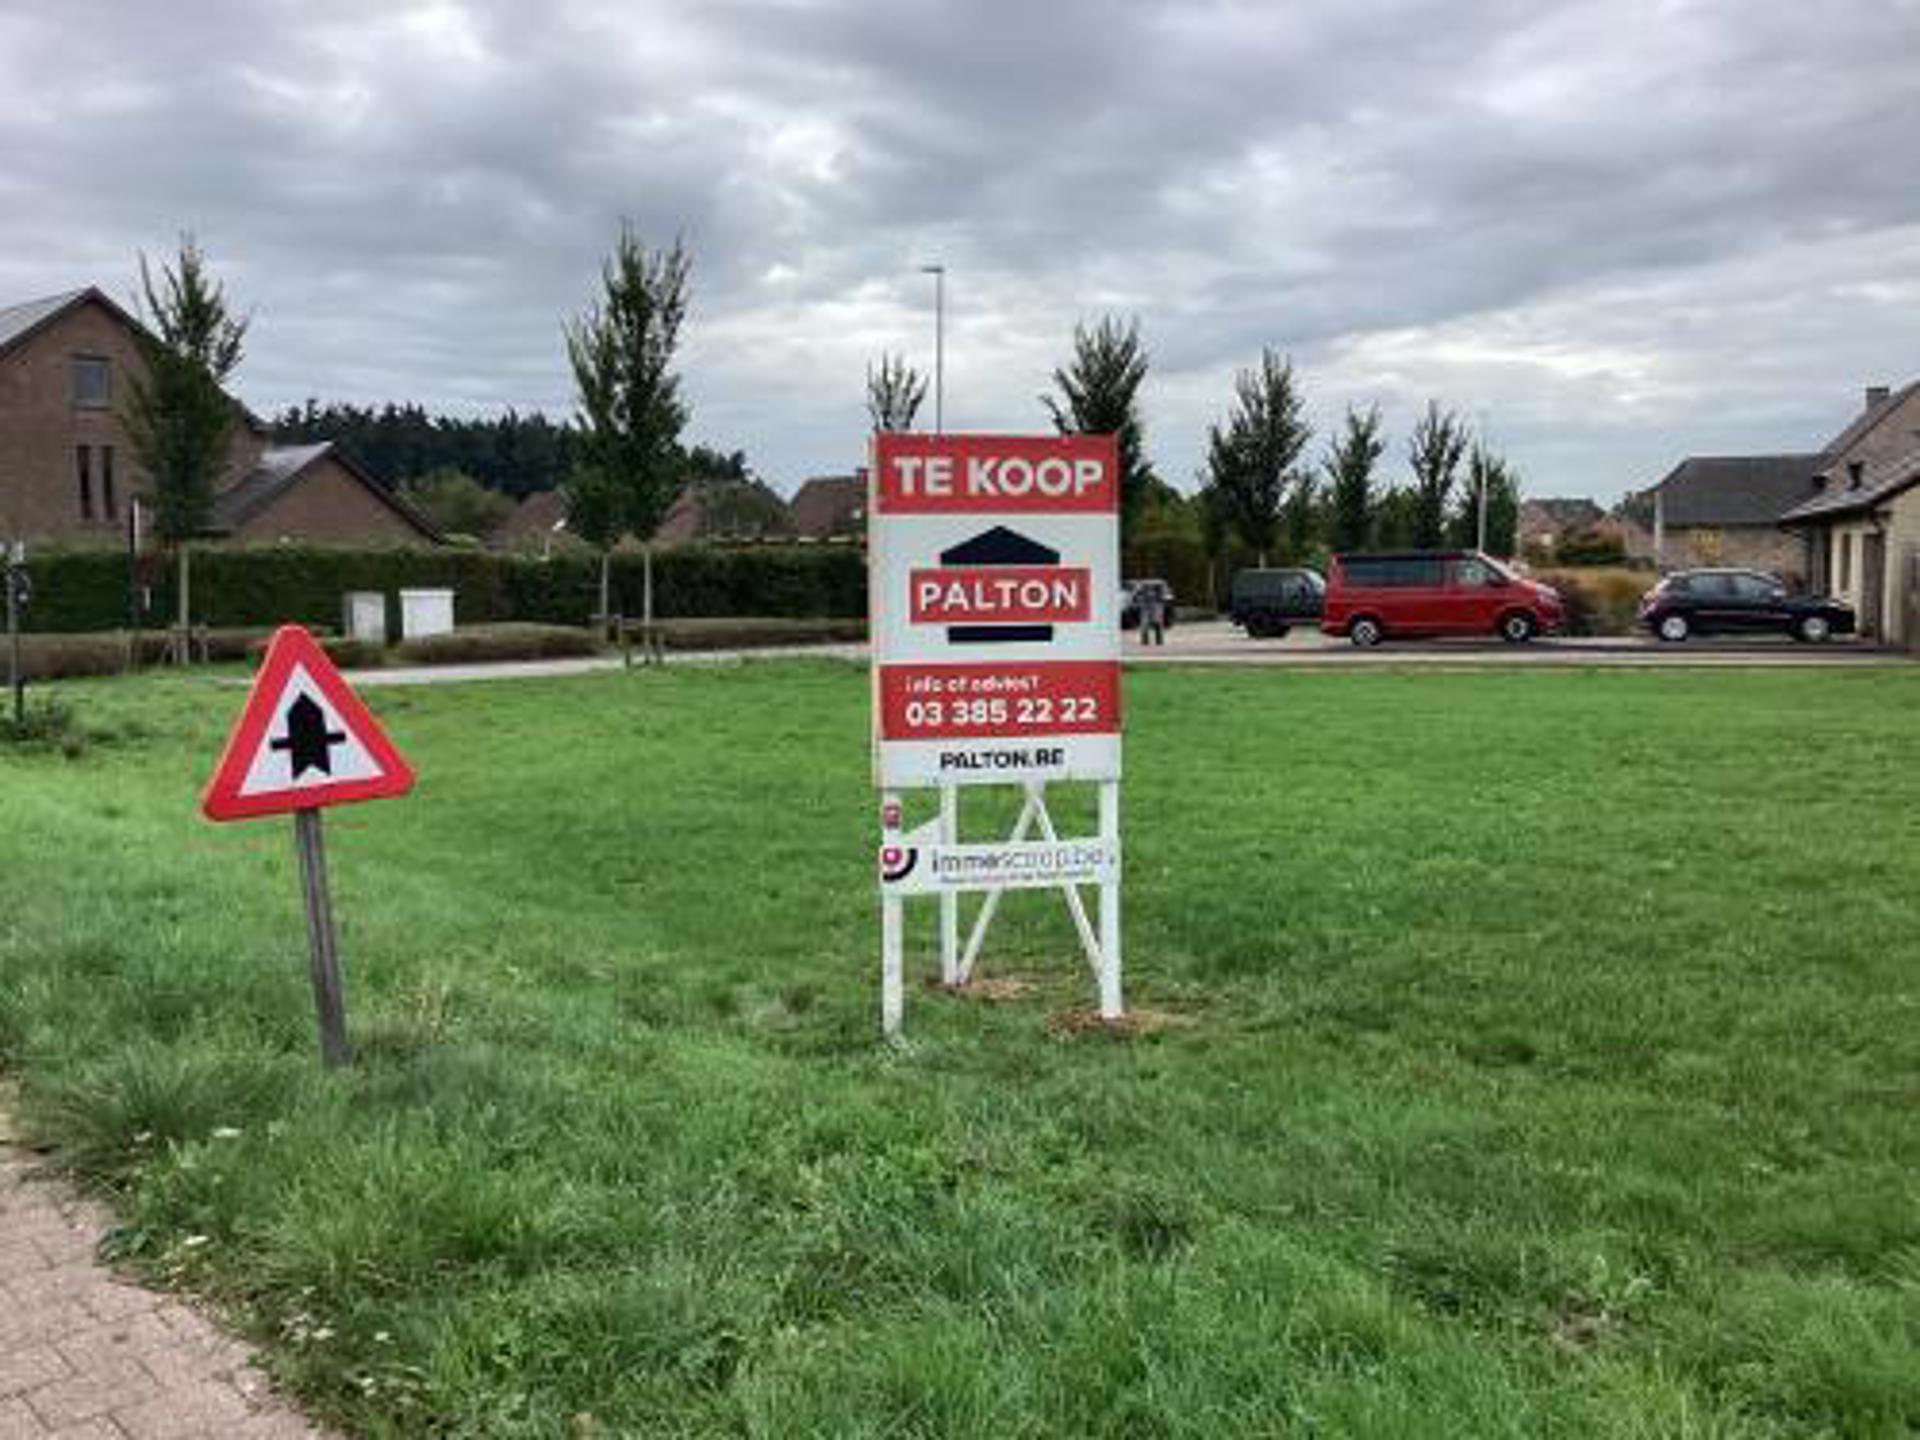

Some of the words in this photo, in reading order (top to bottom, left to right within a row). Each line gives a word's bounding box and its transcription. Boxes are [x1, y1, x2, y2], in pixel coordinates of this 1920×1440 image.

[894, 457, 953, 495] TE
[967, 457, 1103, 495] KOOP
[919, 580, 1078, 612] PALTON
[905, 701, 942, 726] 03
[951, 699, 1007, 724] 385
[1017, 699, 1053, 723] 22
[1060, 697, 1097, 721] 22
[939, 748, 1065, 769] PALTON.BE
